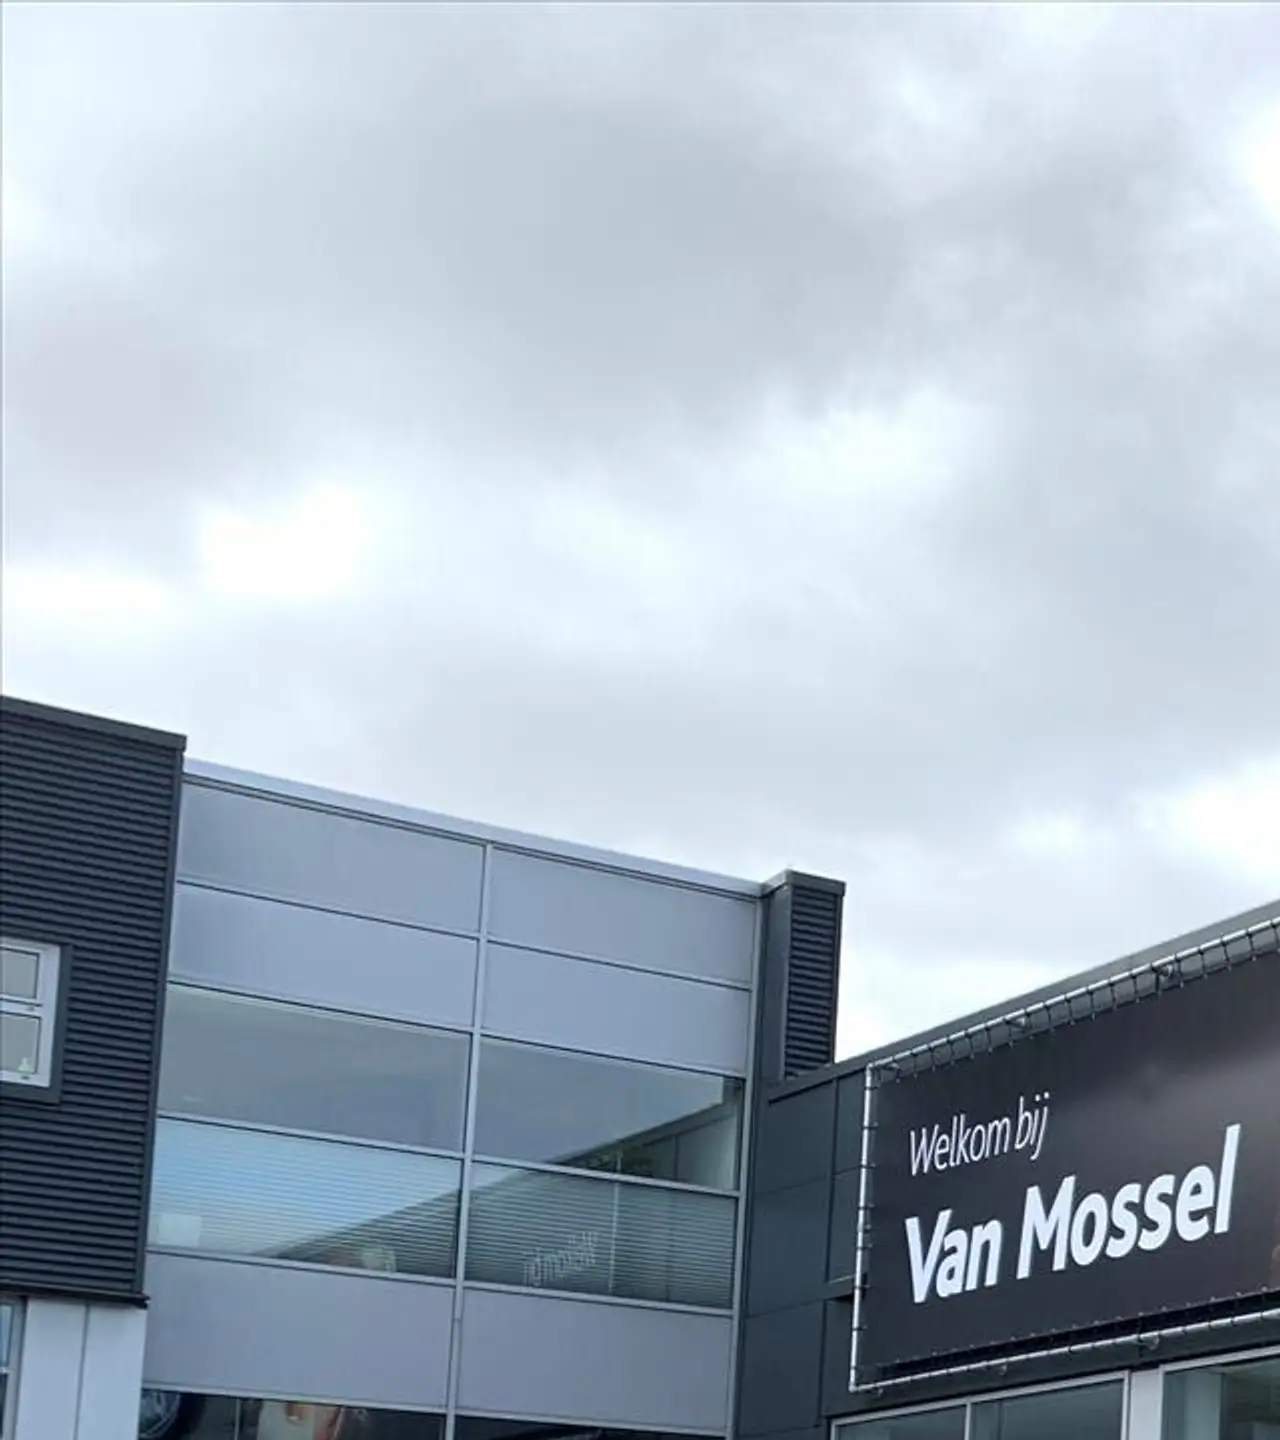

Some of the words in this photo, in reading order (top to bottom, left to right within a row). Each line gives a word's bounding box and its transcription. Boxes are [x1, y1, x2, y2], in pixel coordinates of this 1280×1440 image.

[910, 1113, 1010, 1176] Welkom
[1015, 1092, 1050, 1161] bij
[905, 1208, 1002, 1304] Van
[1016, 1173, 1242, 1280] Mossel
